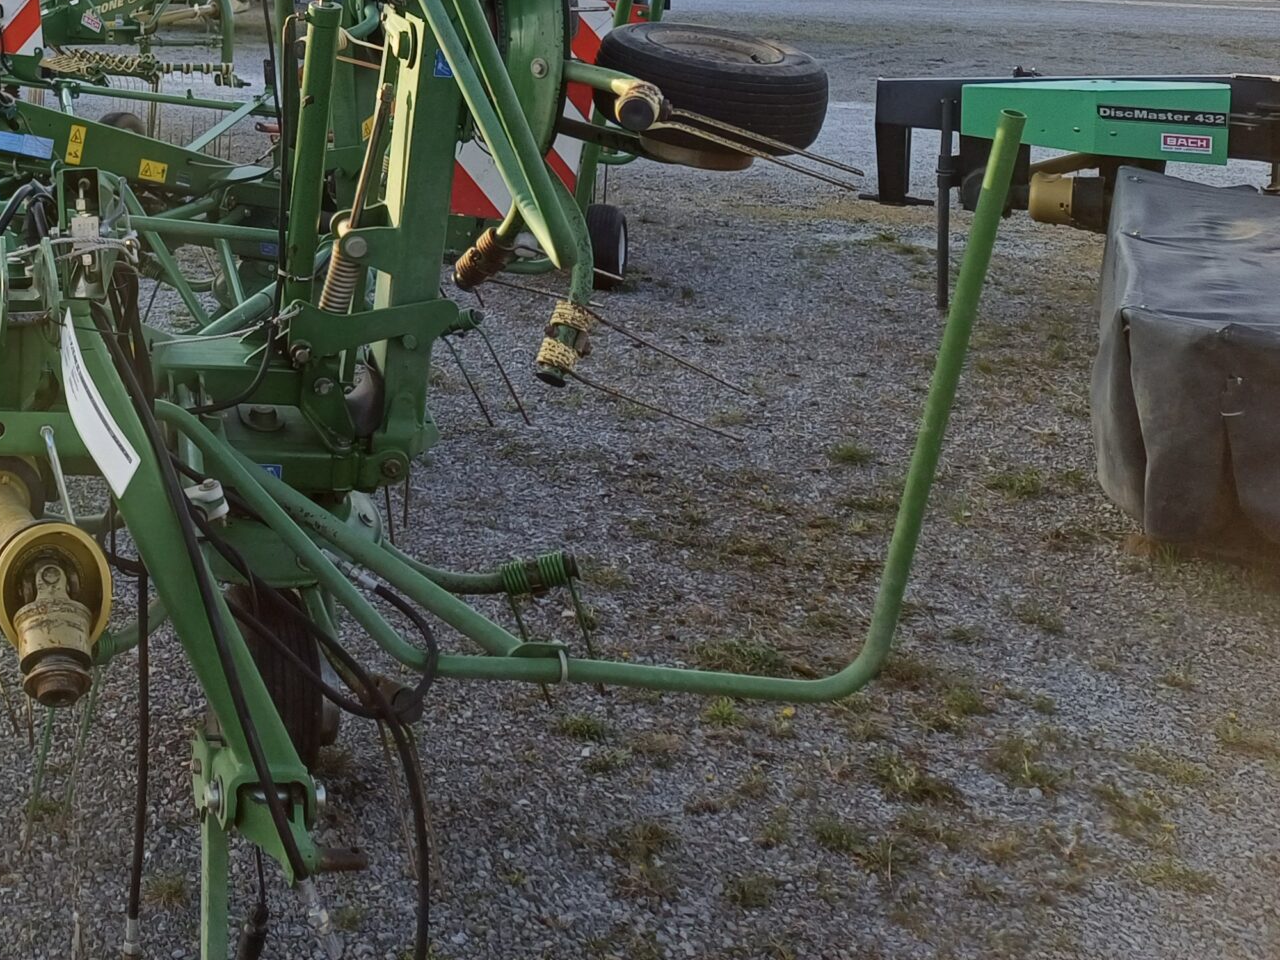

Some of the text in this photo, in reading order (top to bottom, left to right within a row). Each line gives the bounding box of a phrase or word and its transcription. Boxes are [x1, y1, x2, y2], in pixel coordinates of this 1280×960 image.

[1099, 107, 1225, 124] DiscMaster 432
[1166, 137, 1207, 147] BACH
